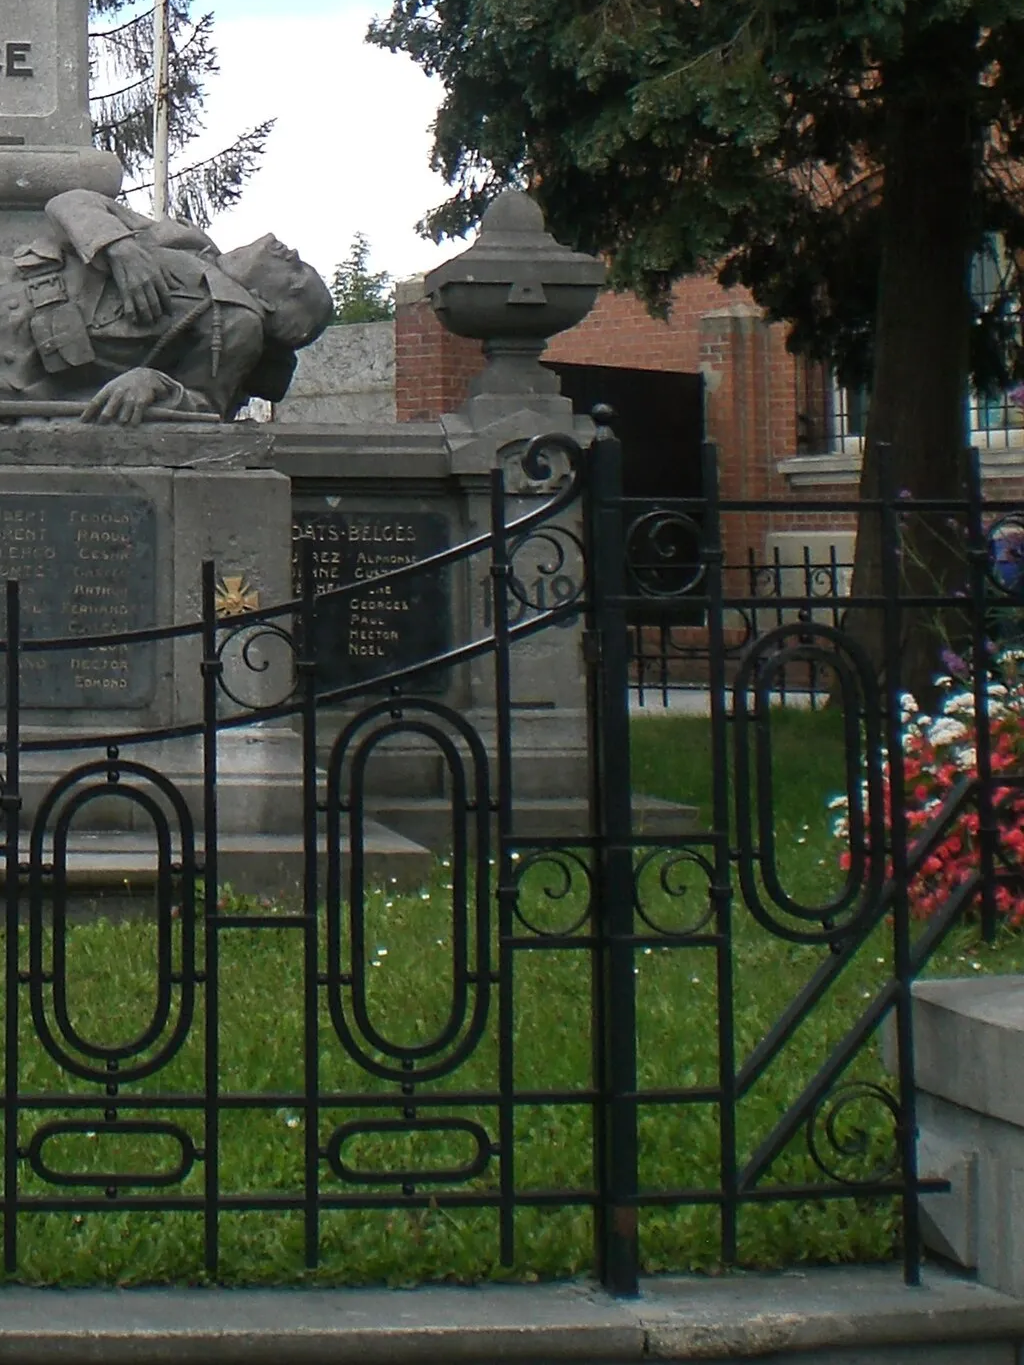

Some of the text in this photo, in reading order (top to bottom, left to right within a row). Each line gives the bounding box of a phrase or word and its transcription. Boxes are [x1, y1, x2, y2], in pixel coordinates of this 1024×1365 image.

[350, 597, 410, 611] GEORGES
[350, 613, 385, 626] PAUL
[349, 629, 400, 641] HECTOR
[74, 675, 128, 690] EDMOND
